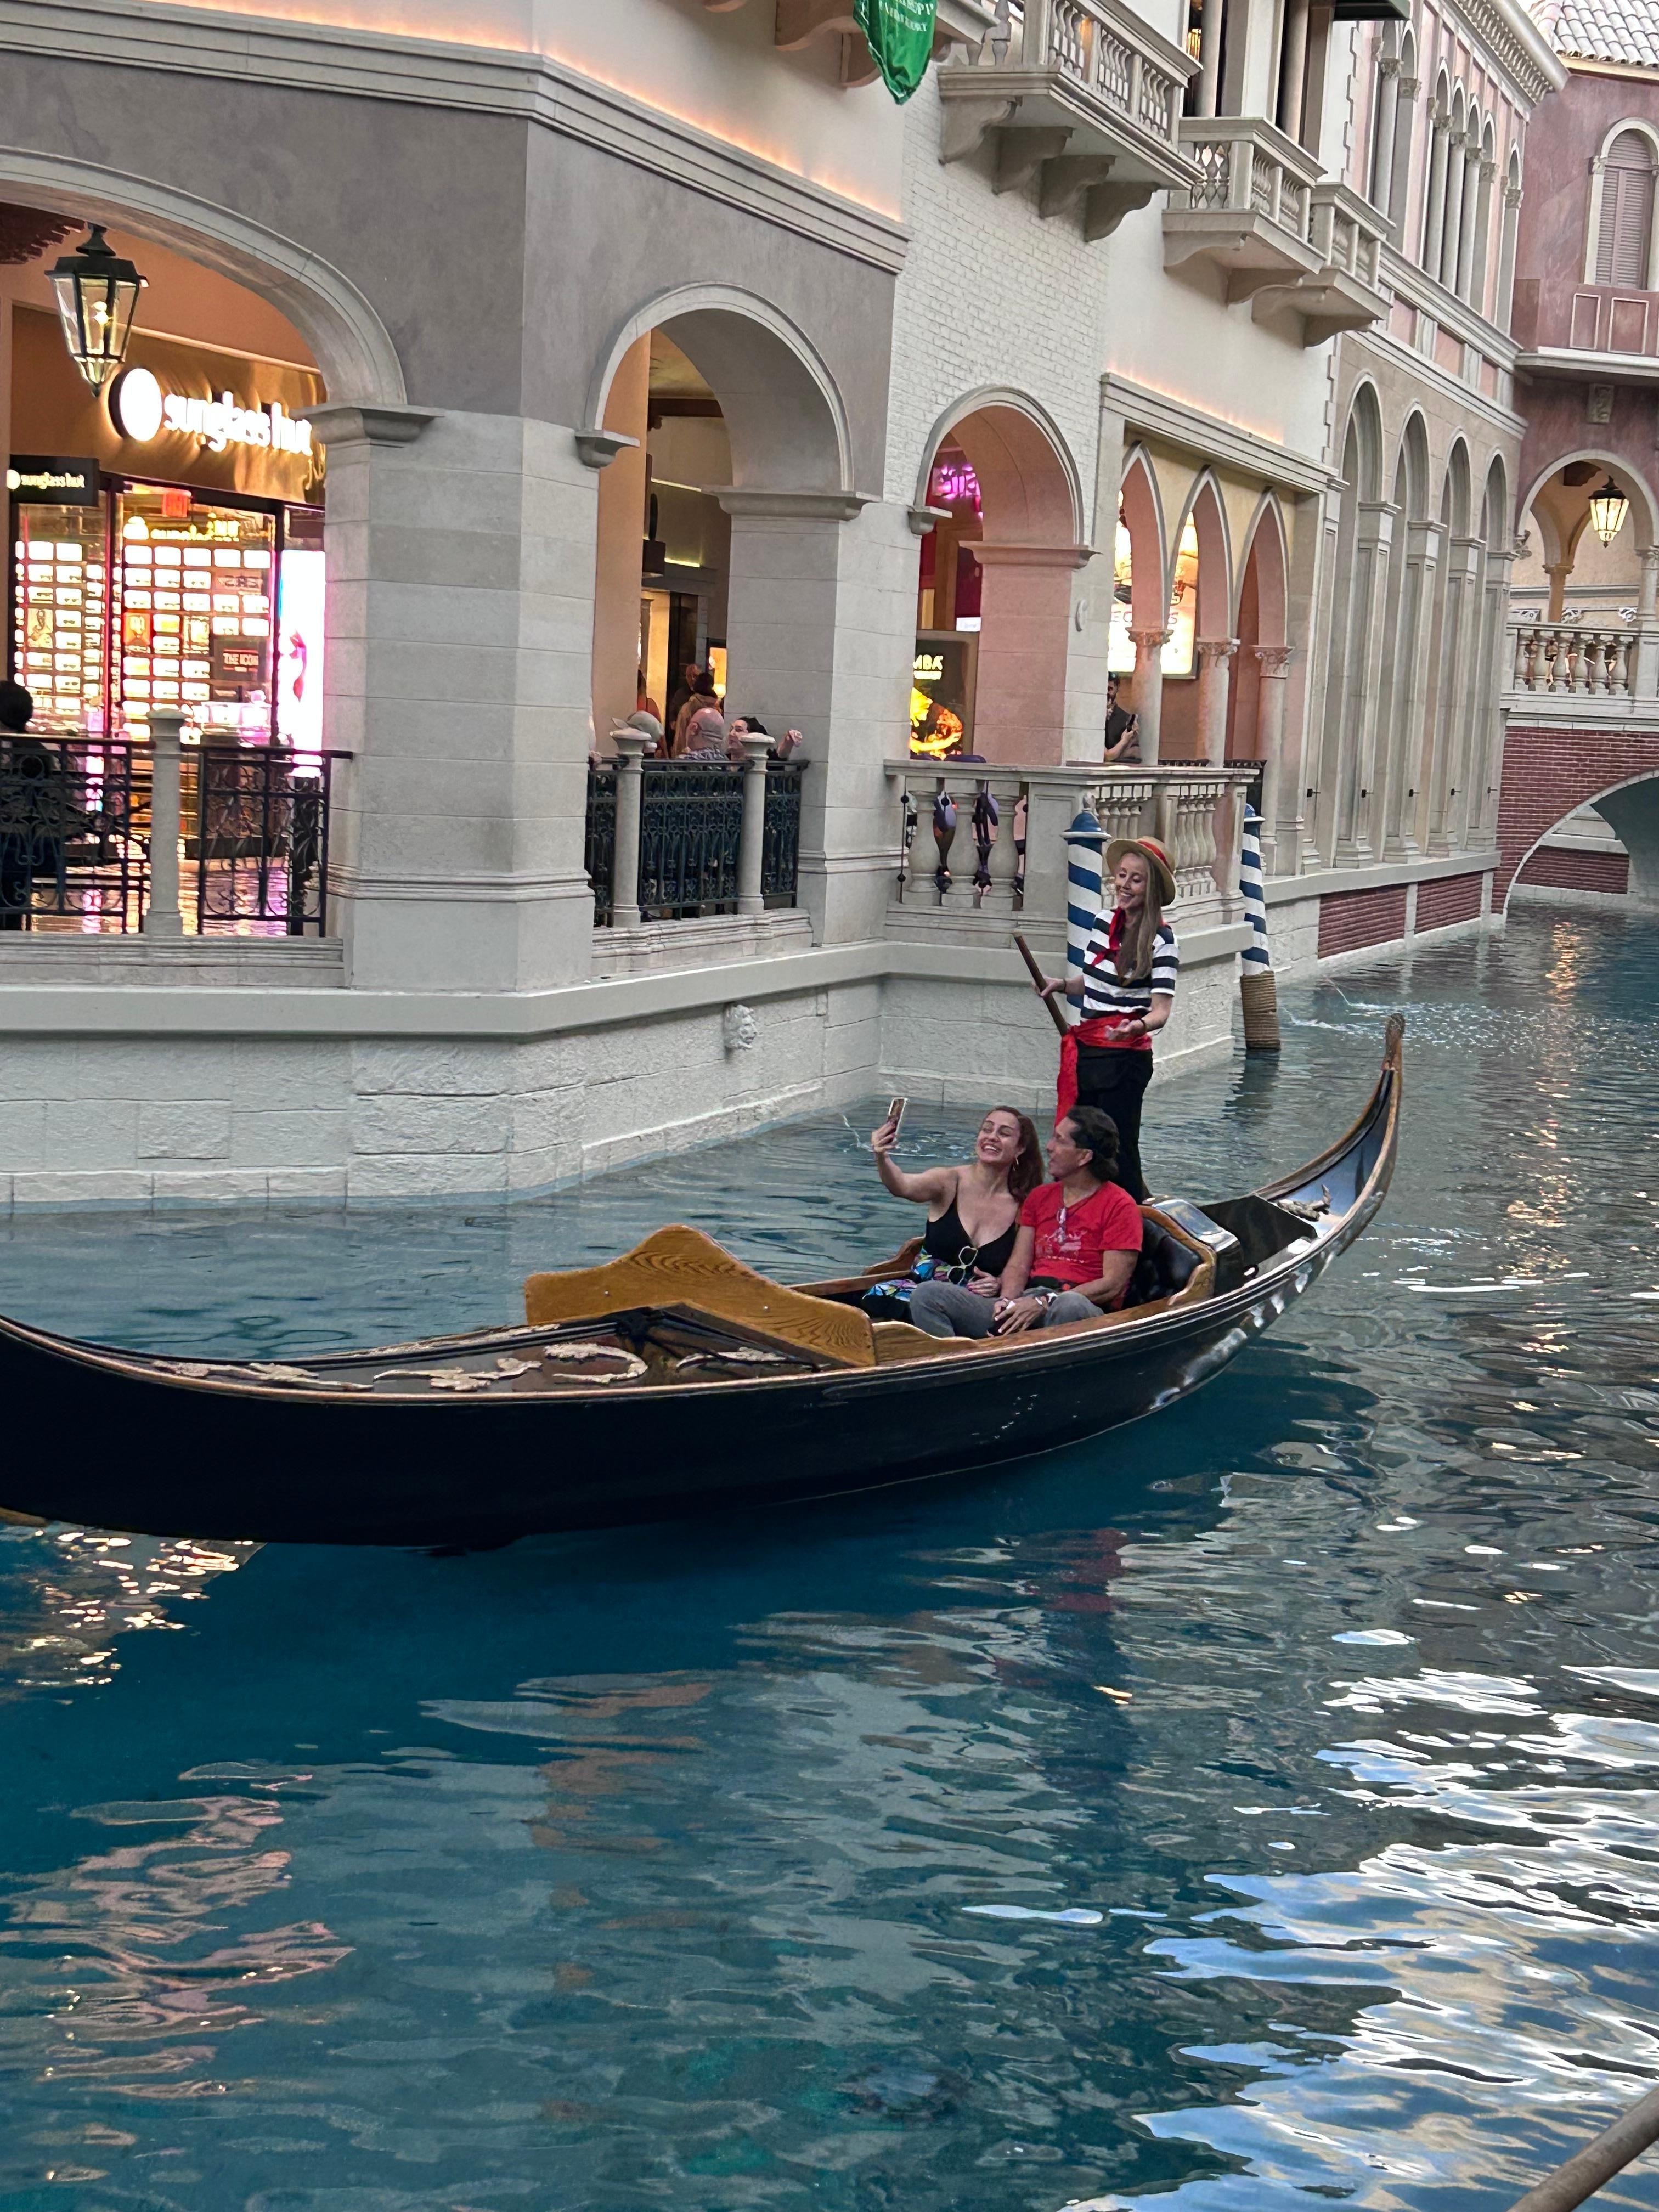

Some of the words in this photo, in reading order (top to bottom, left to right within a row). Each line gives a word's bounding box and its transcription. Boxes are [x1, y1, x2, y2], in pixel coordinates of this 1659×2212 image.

[163, 391, 271, 453] sunglass
[271, 402, 313, 456] hut
[21, 472, 66, 489] sunglass
[65, 472, 86, 488] hut
